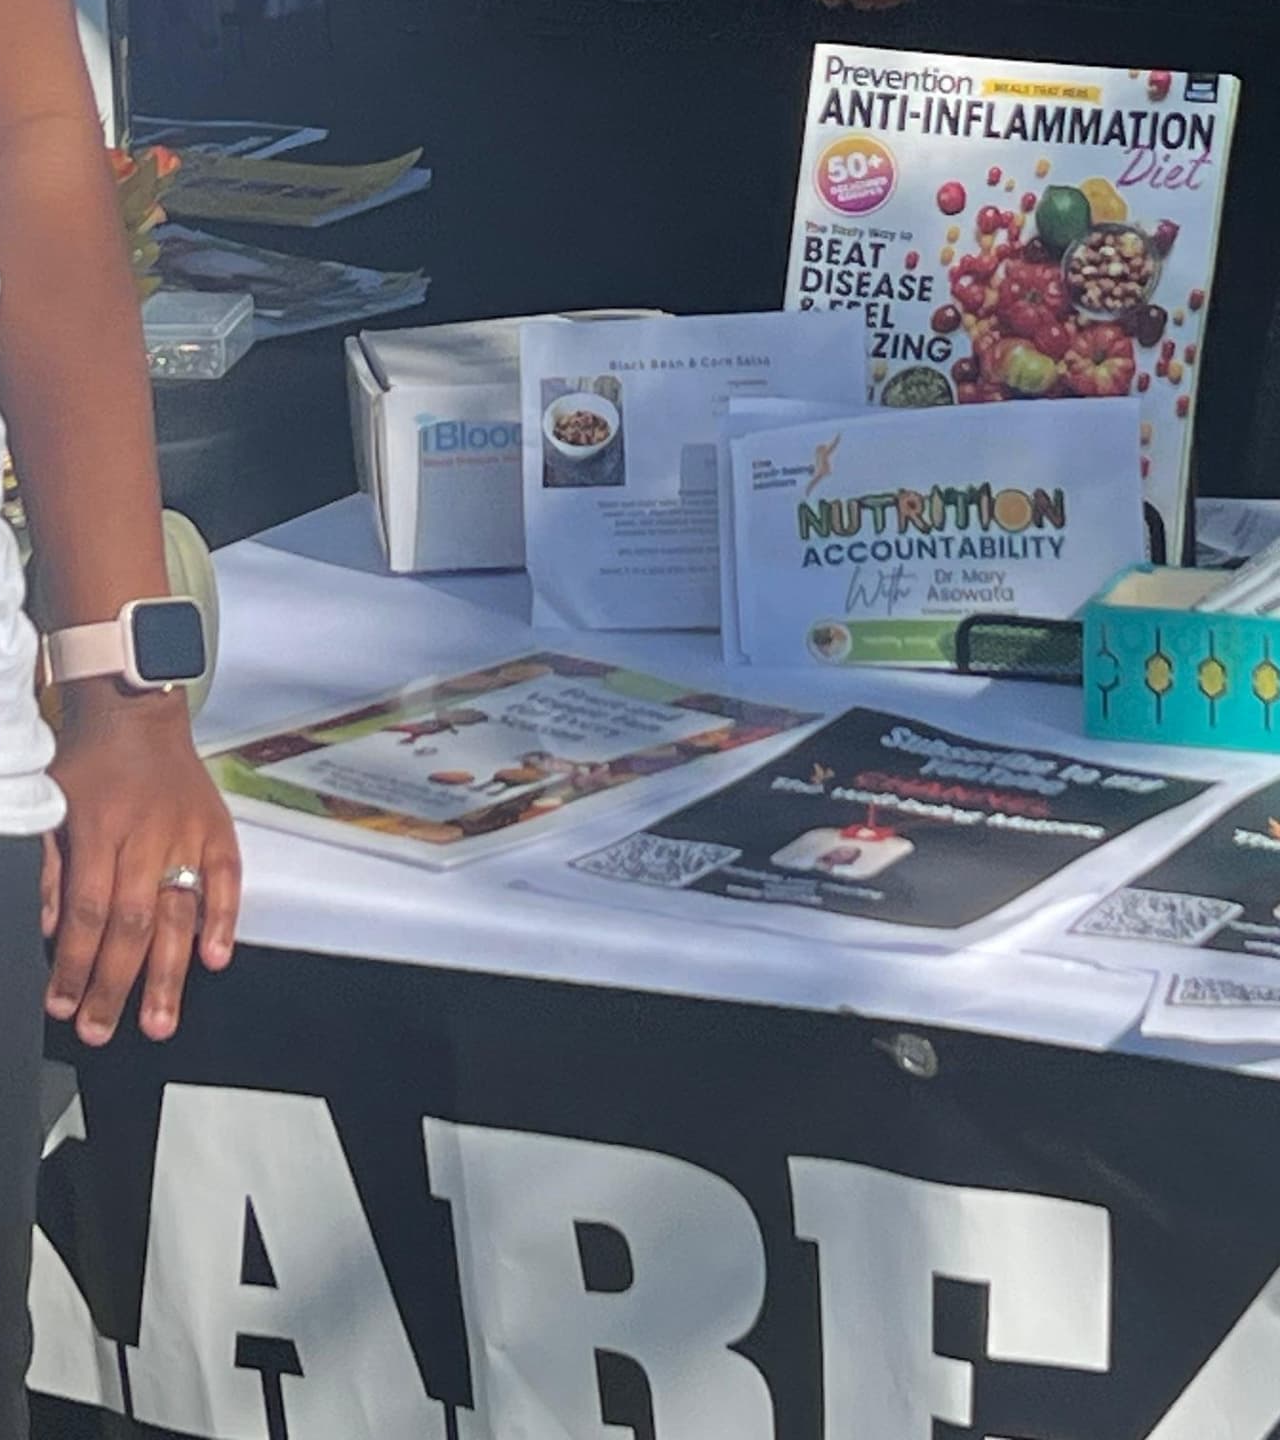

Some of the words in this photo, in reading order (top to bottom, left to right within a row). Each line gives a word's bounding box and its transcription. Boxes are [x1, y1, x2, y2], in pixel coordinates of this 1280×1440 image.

[825, 56, 973, 95] Prevention
[819, 88, 1215, 153] ANTI-INFLAMMATION
[827, 152, 884, 183] 50+
[1117, 143, 1213, 189] Diet
[804, 236, 886, 269] BEAT
[800, 267, 933, 303] DISEASE
[797, 481, 1067, 541] NUTRITION
[802, 535, 1067, 569] ACCOUNTABILITY
[845, 563, 917, 616] With
[961, 569, 1007, 591] Mary
